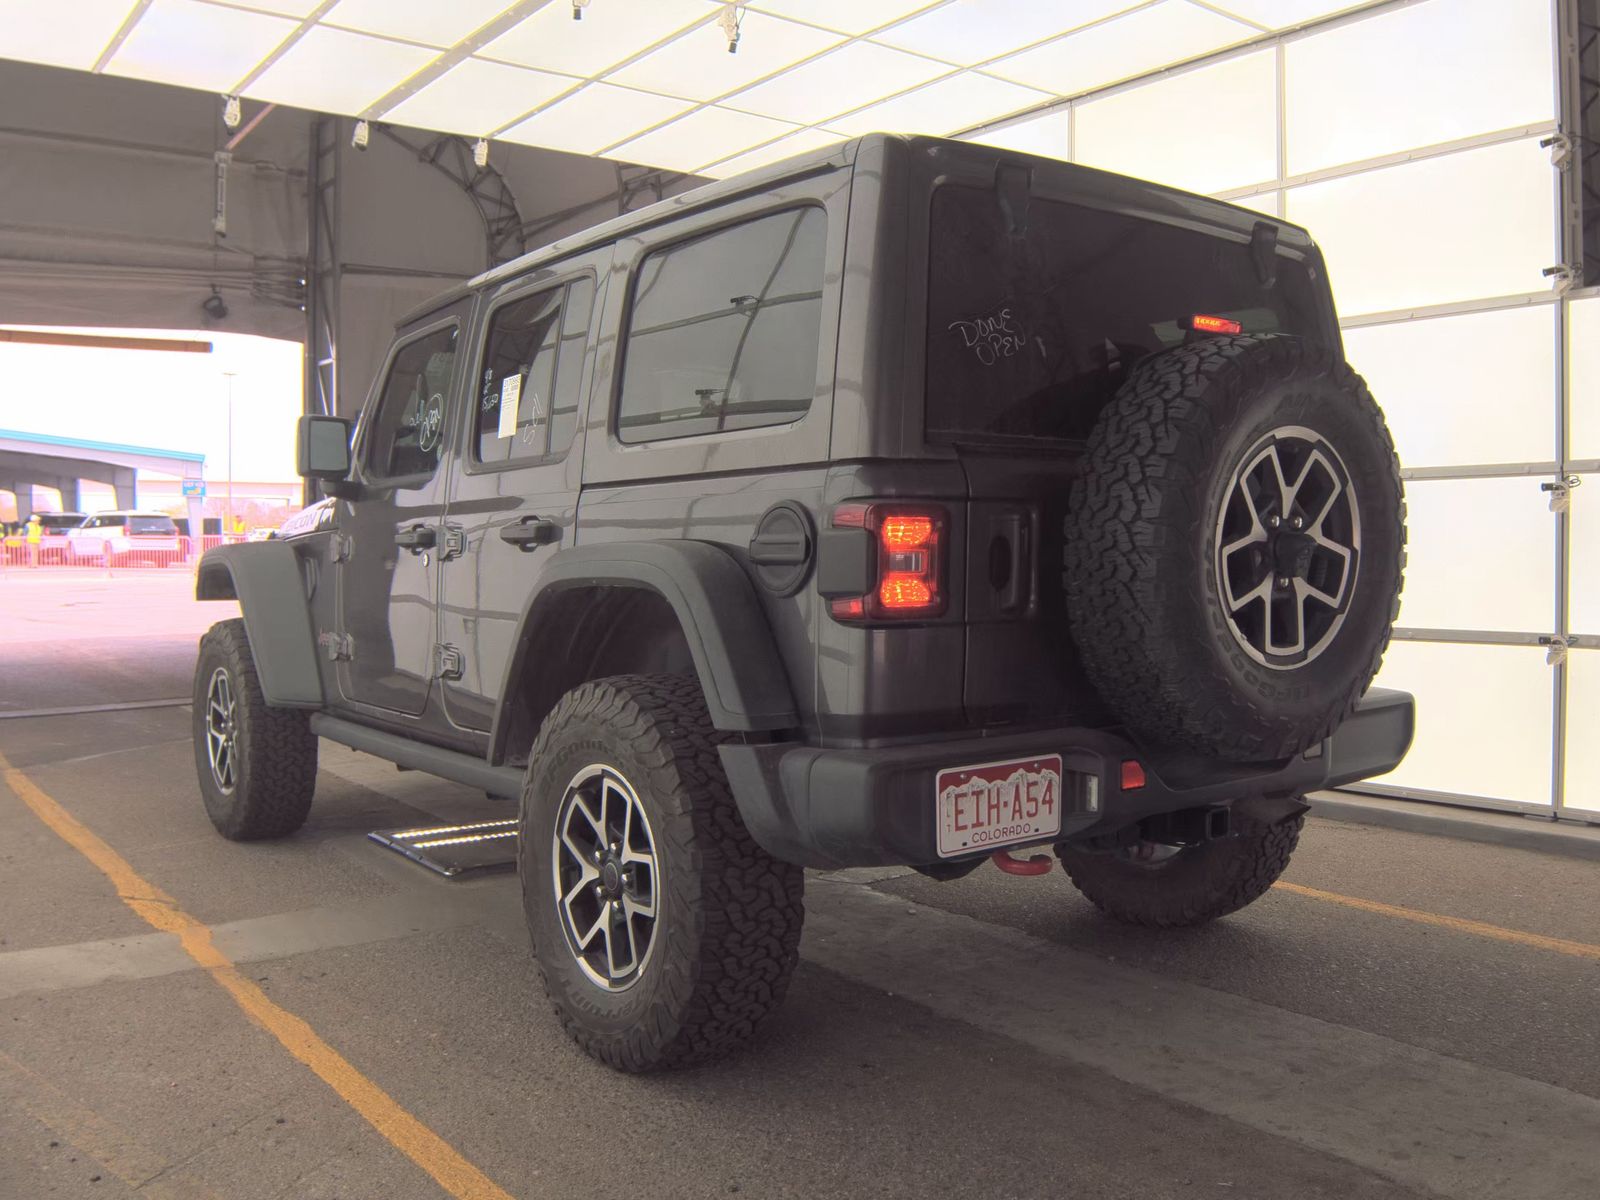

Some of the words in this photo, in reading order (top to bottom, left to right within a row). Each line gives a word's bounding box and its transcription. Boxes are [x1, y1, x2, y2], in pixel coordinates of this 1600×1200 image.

[947, 308, 1015, 347] DONE
[976, 331, 1026, 366] OPEN
[971, 822, 1031, 844] COLORADO
